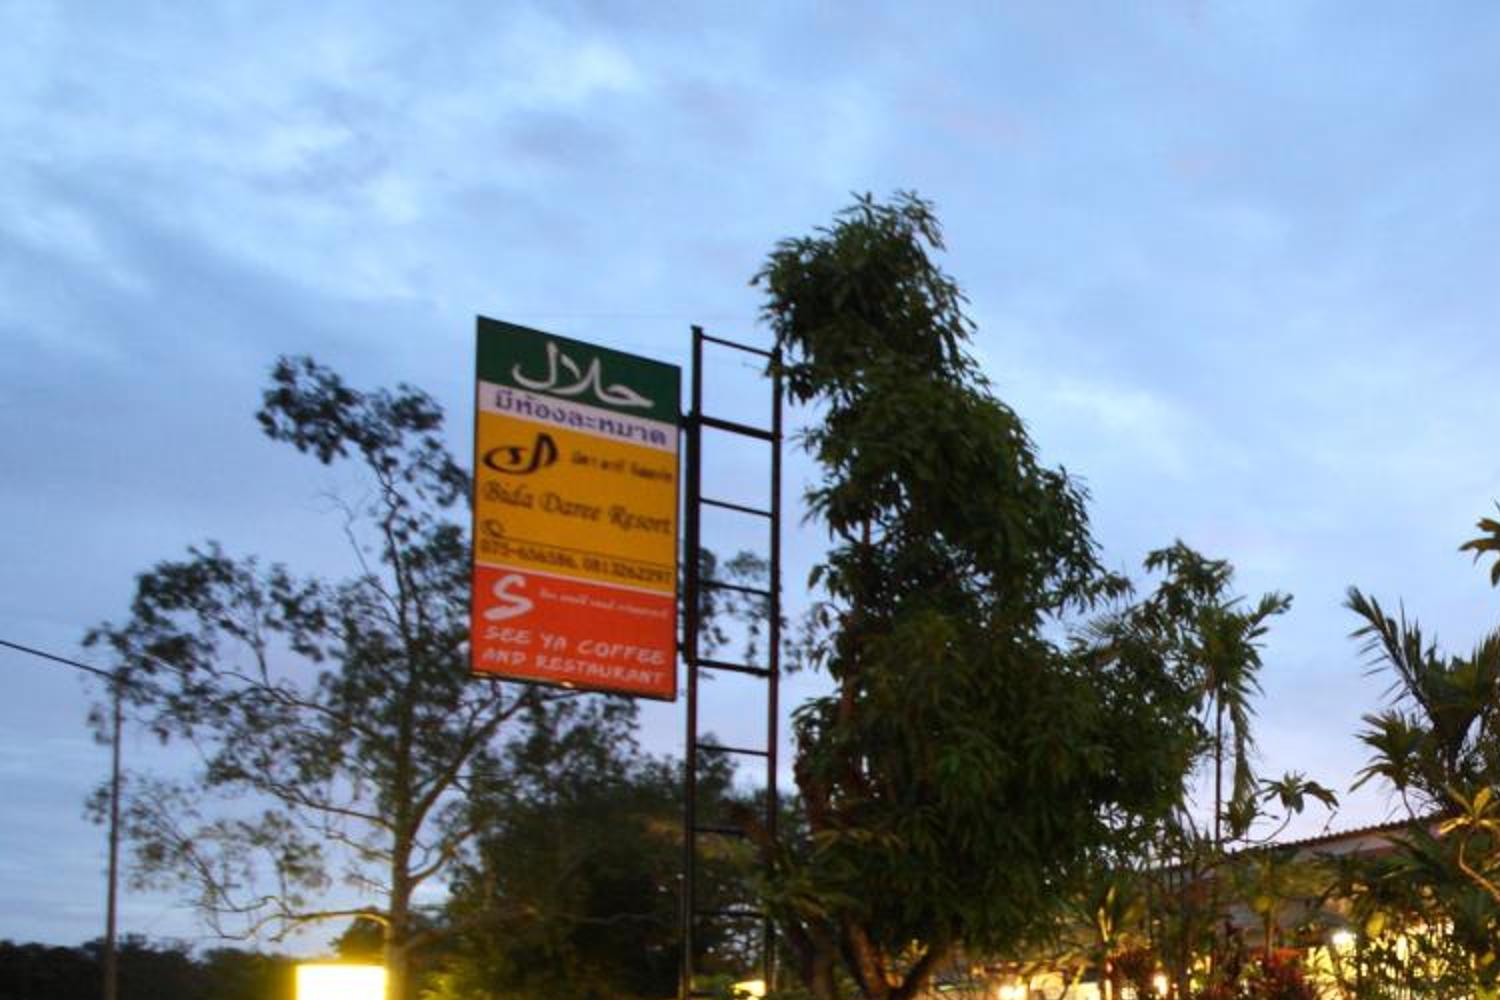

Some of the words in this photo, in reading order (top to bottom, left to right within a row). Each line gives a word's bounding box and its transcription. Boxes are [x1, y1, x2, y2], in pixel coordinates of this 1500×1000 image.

[511, 339, 655, 408] حلال
[479, 647, 527, 665] AND
[535, 653, 664, 685] RESTAURANT
[483, 625, 531, 644] SEE
[577, 638, 666, 666] COFFEE
